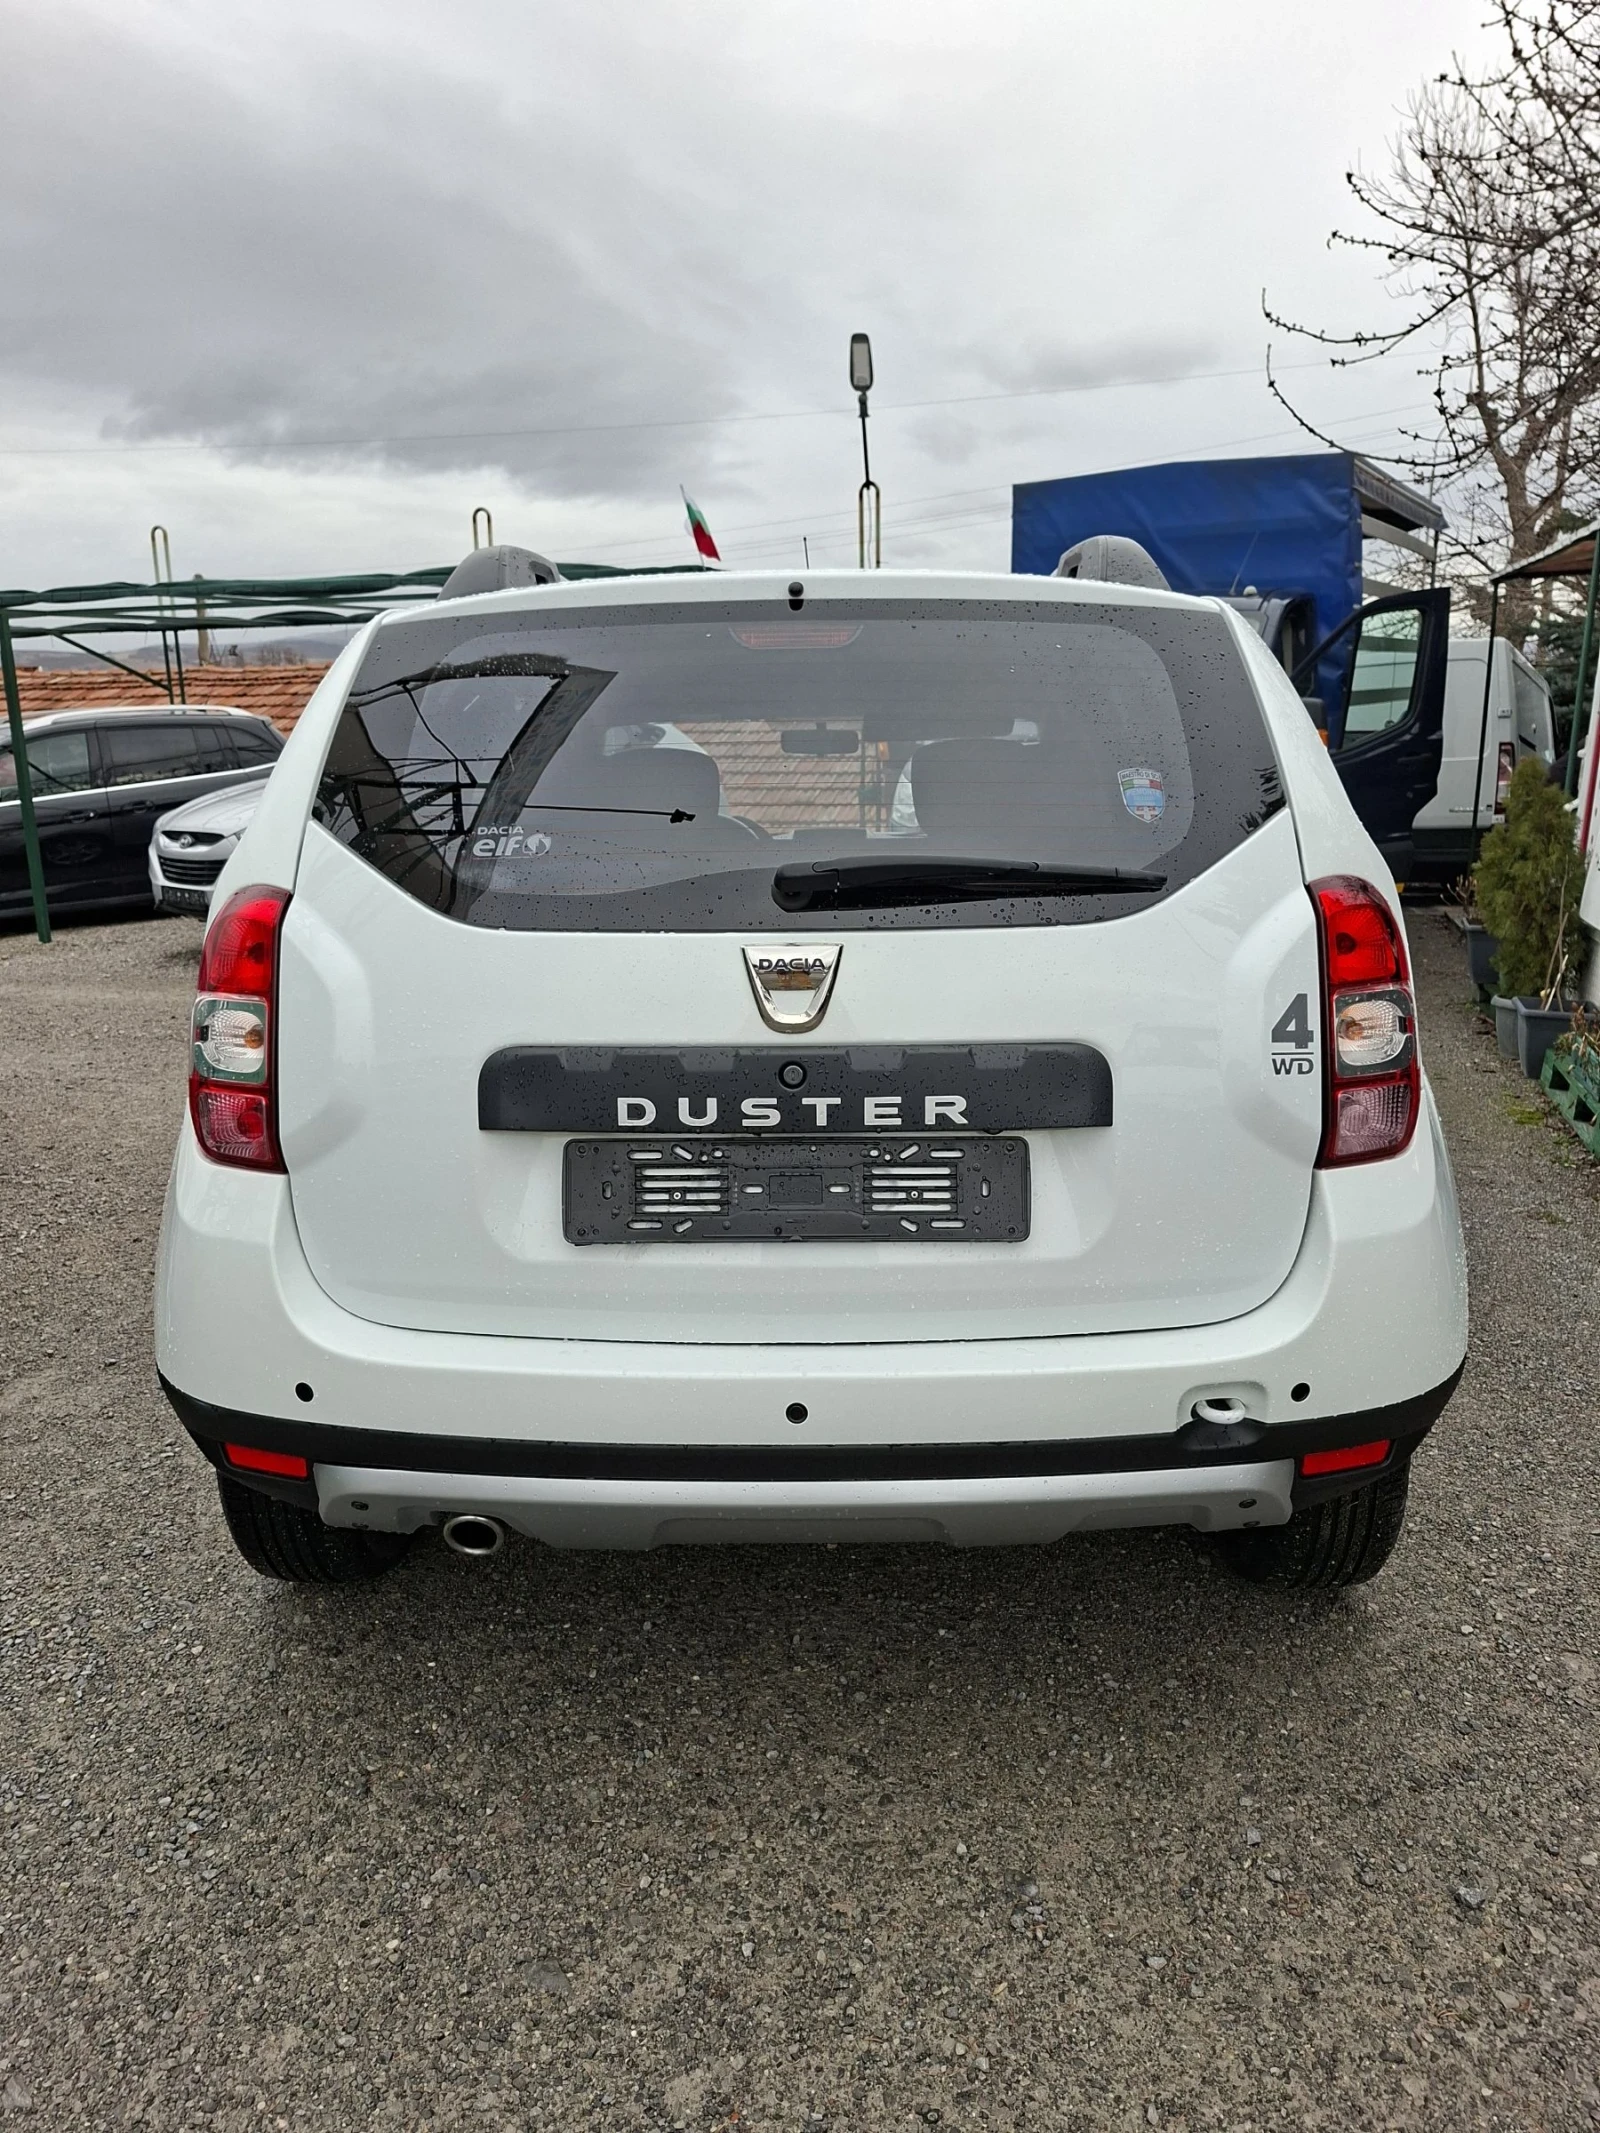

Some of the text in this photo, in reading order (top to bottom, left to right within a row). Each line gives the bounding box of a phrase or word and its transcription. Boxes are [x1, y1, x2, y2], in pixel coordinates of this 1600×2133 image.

[1122, 771, 1144, 779] MAESTRO
[477, 826, 524, 835] DACIA
[473, 836, 523, 857] elf
[758, 958, 826, 971] DACIA
[1271, 993, 1314, 1049] 4
[1271, 1058, 1314, 1075] WD
[617, 1096, 968, 1126] DUSTER
